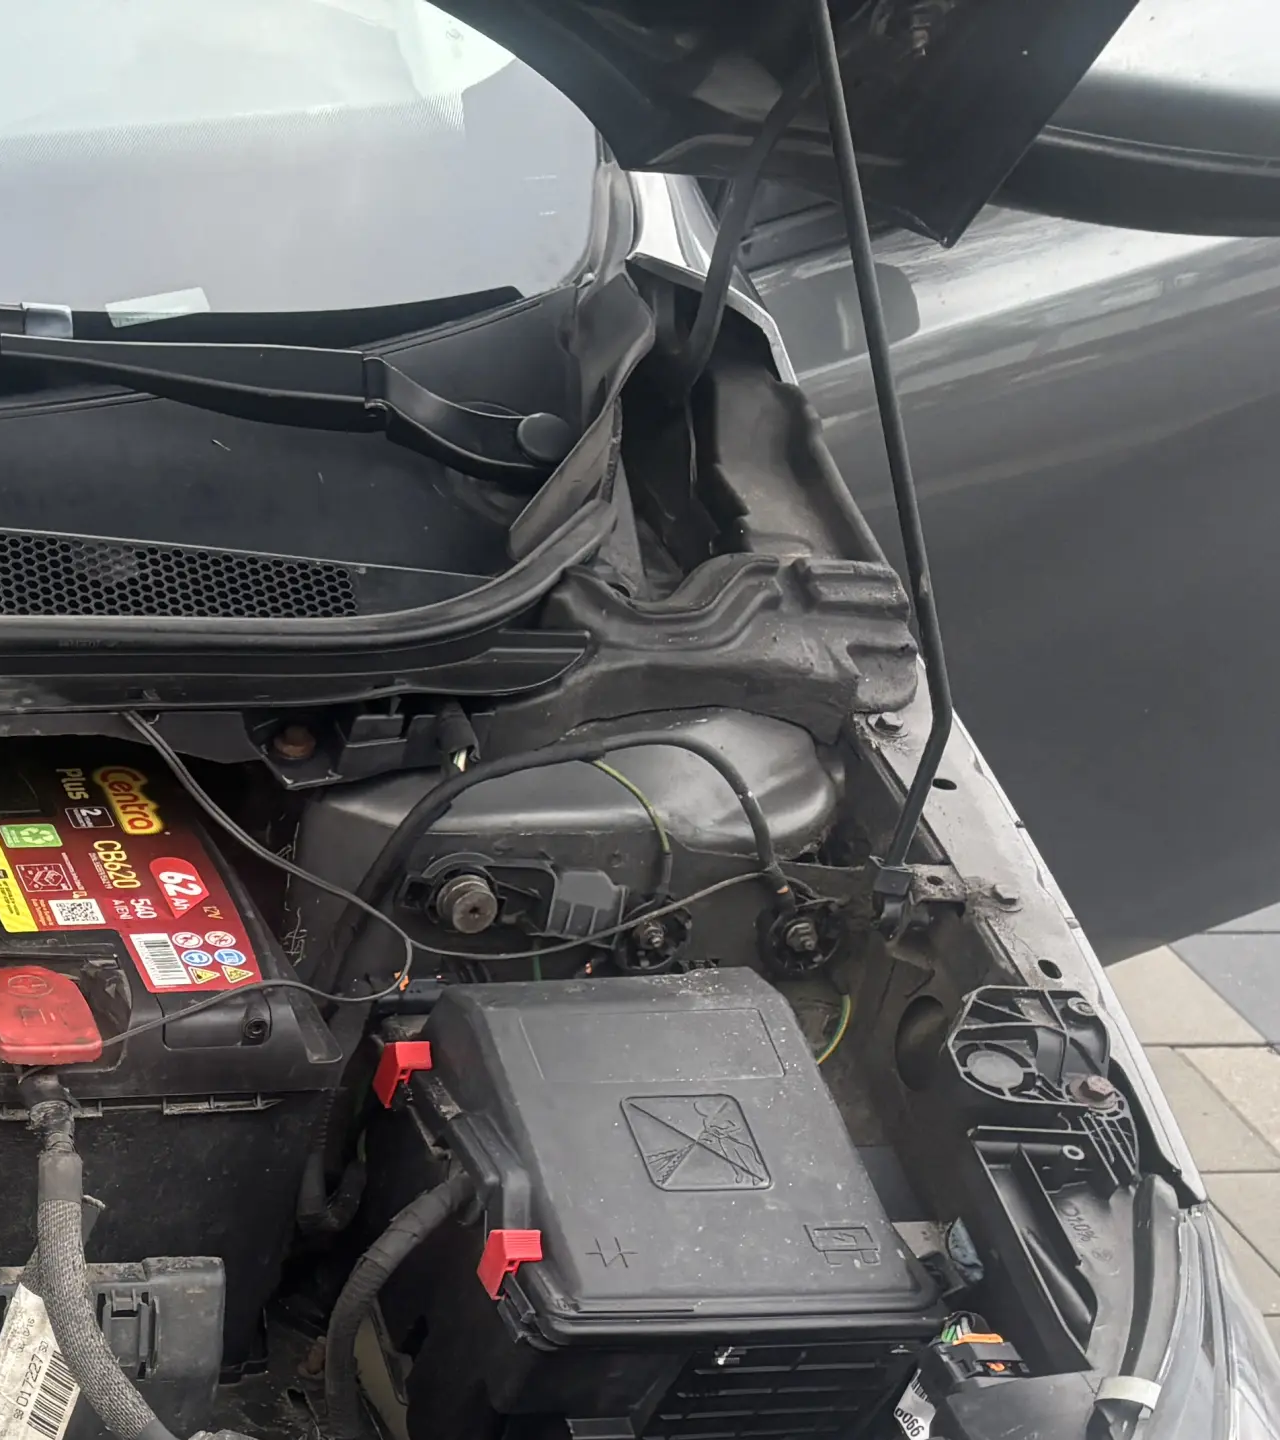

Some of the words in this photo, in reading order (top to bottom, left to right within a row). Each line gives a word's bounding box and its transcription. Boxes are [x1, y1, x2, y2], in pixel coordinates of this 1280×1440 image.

[100, 768, 155, 830] Centro
[93, 840, 142, 889] CB620
[158, 871, 203, 897] 62
[130, 897, 158, 920] 540
[170, 897, 191, 911] Ah
